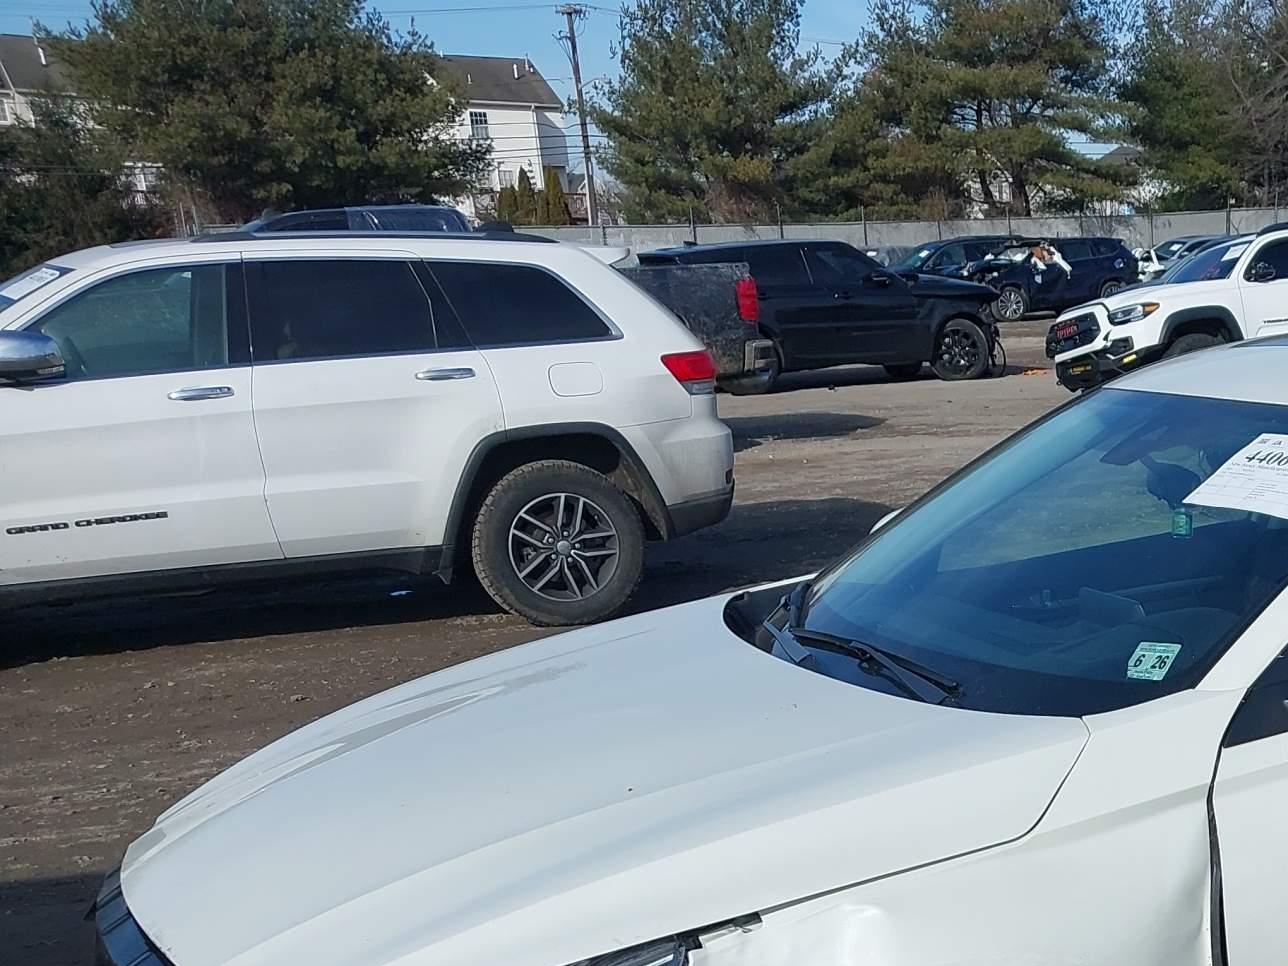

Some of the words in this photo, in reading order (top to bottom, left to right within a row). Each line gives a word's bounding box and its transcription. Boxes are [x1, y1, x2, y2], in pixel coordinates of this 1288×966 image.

[6, 521, 69, 535] GRAND
[74, 510, 169, 528] CHEROKEE
[1133, 653, 1147, 668] 6
[1149, 654, 1170, 670] 26
